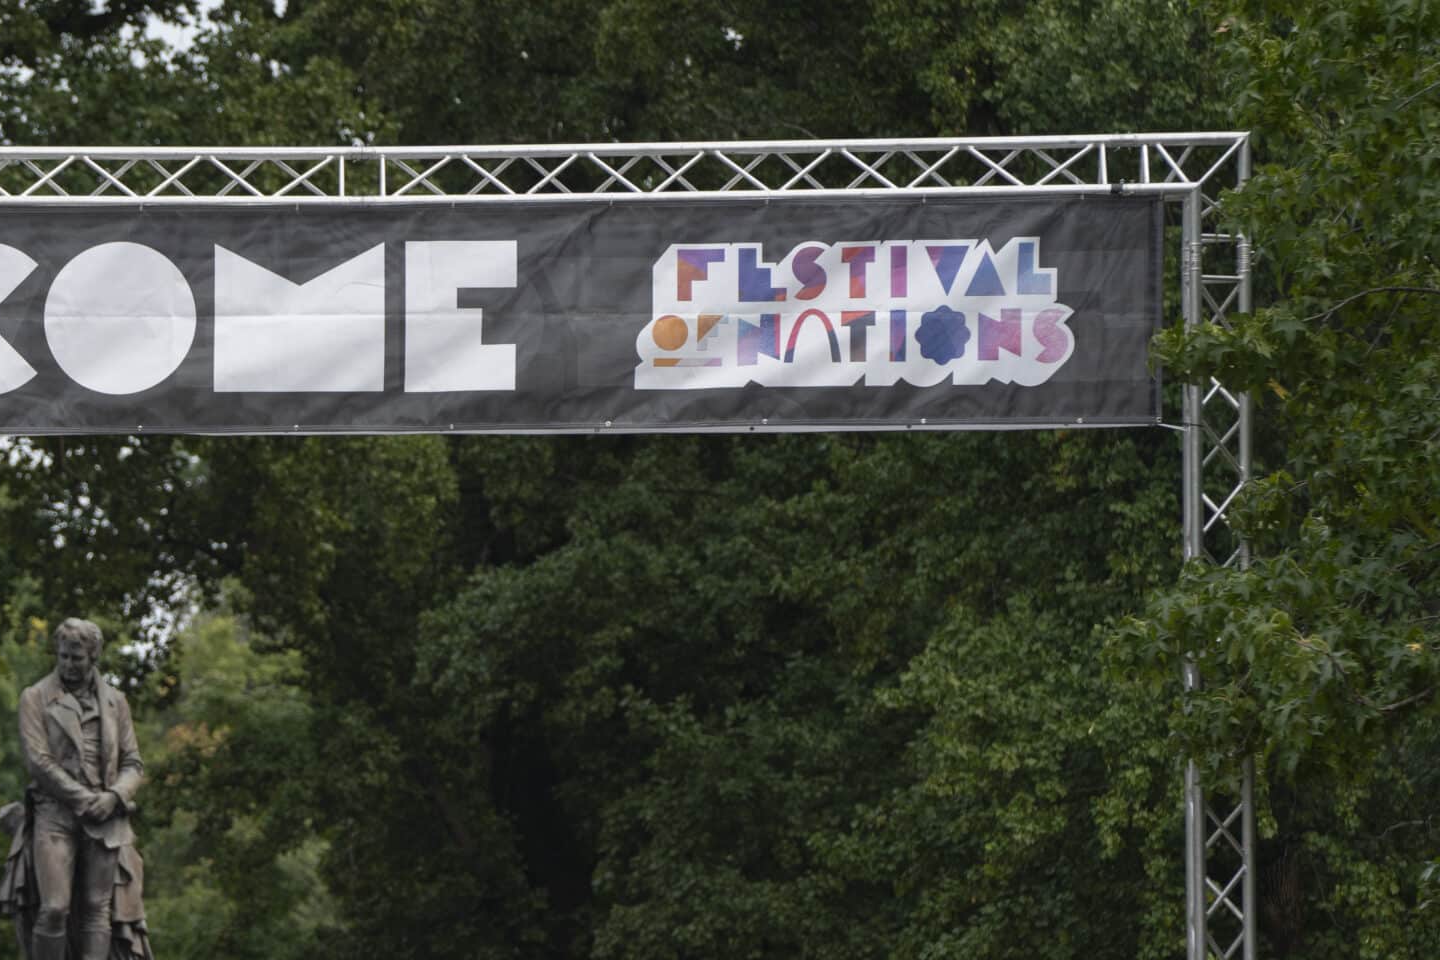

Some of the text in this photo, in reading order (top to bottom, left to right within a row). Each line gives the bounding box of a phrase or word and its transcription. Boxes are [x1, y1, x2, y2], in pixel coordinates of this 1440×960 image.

[676, 241, 1052, 303] FESTIVAL
[651, 304, 1070, 367] OF NATIONS
